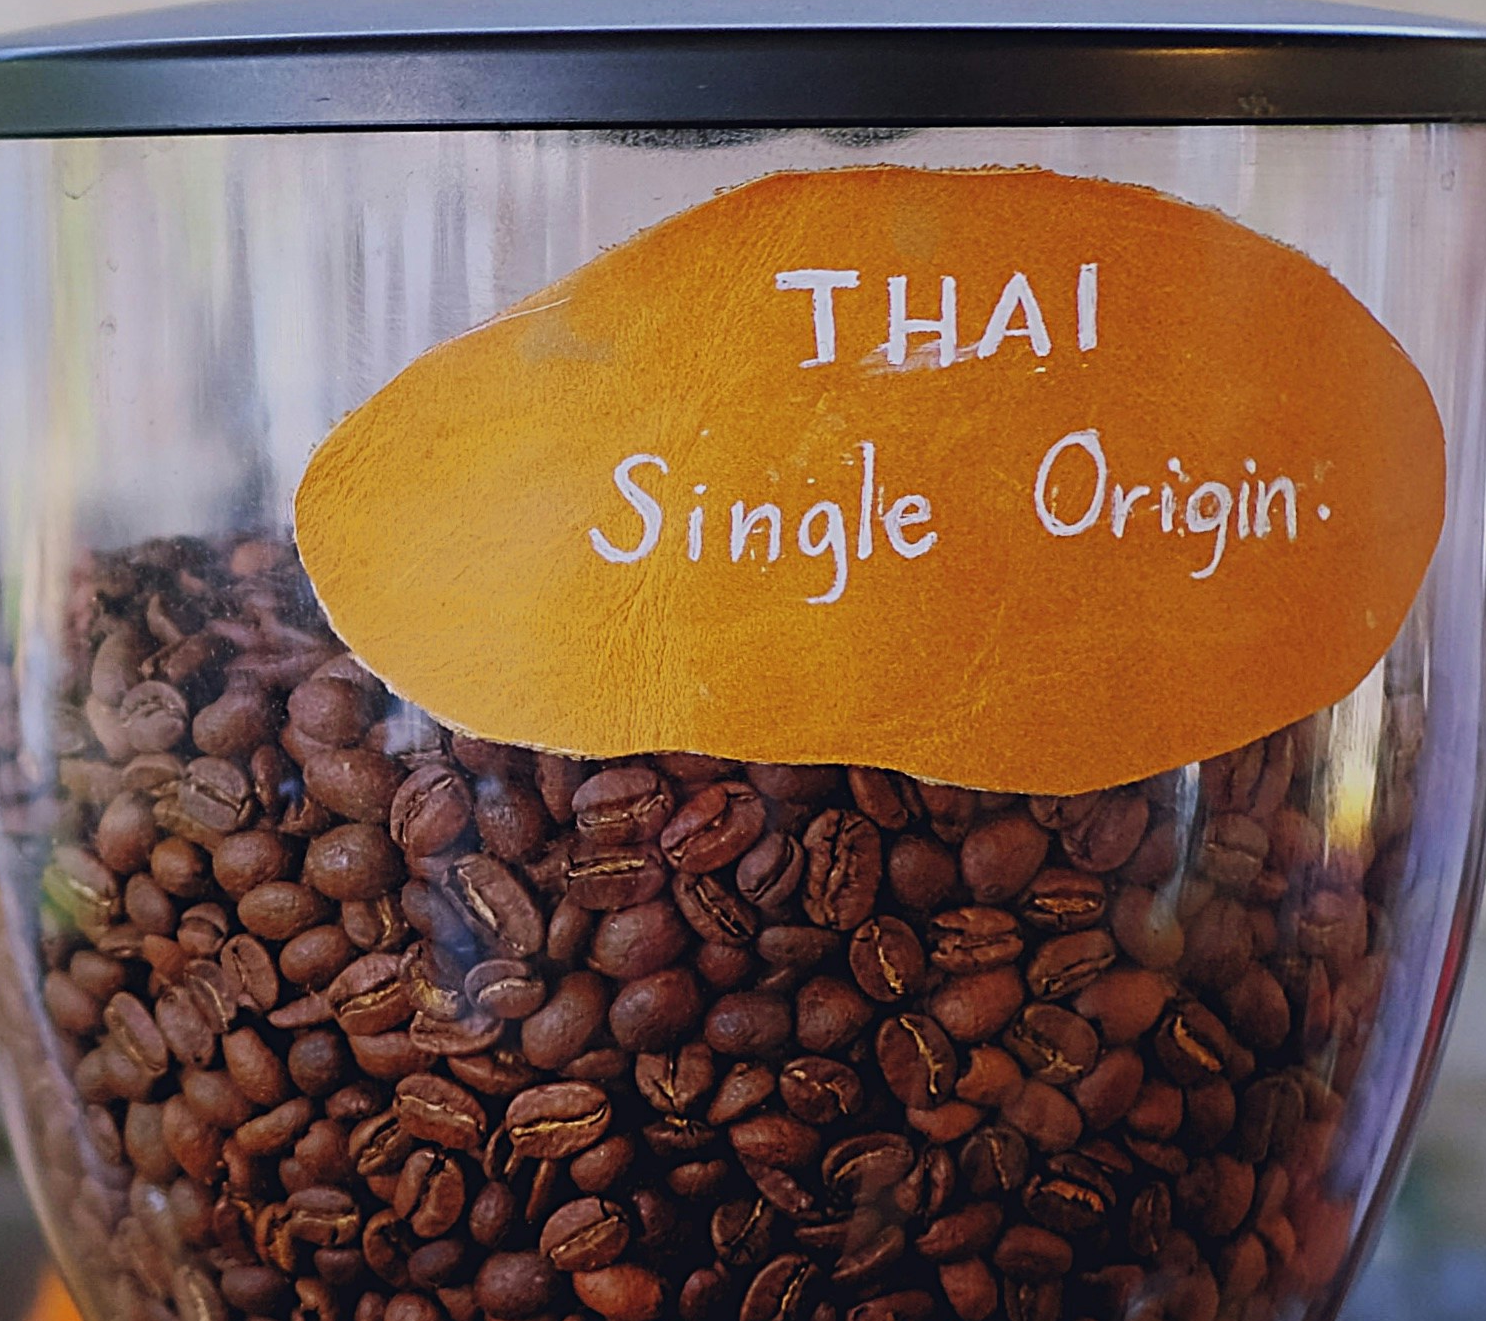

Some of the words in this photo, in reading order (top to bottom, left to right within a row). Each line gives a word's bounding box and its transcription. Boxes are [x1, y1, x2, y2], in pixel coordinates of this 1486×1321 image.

[774, 262, 1099, 371] THAI
[588, 441, 938, 605] Single
[1033, 428, 1331, 580] Origin.
